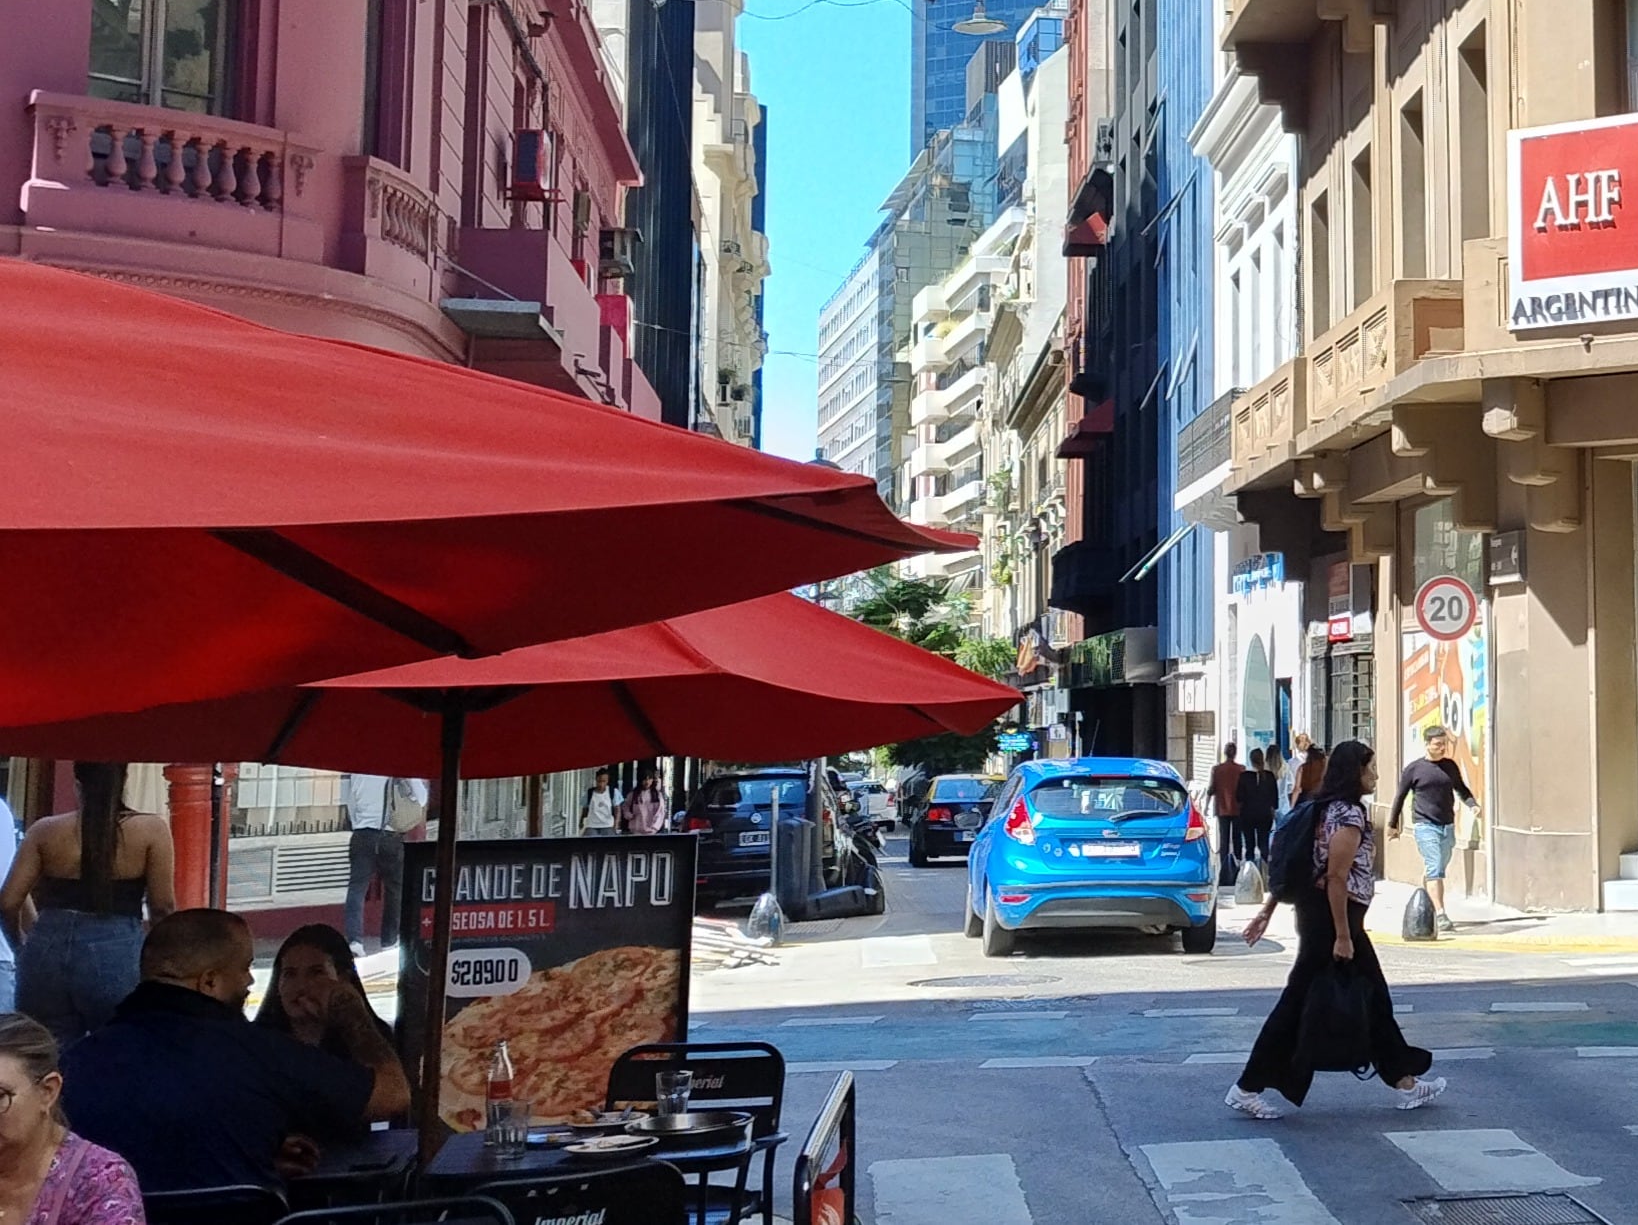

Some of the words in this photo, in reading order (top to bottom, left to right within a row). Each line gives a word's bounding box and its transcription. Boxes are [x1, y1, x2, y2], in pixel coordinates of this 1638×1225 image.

[1533, 168, 1622, 231] AHF
[1429, 596, 1464, 622] 20
[422, 863, 526, 902] GANDE
[531, 863, 564, 899] DE
[568, 850, 675, 910] NAPO
[452, 910, 494, 930] SEOSA
[498, 909, 514, 928] DE
